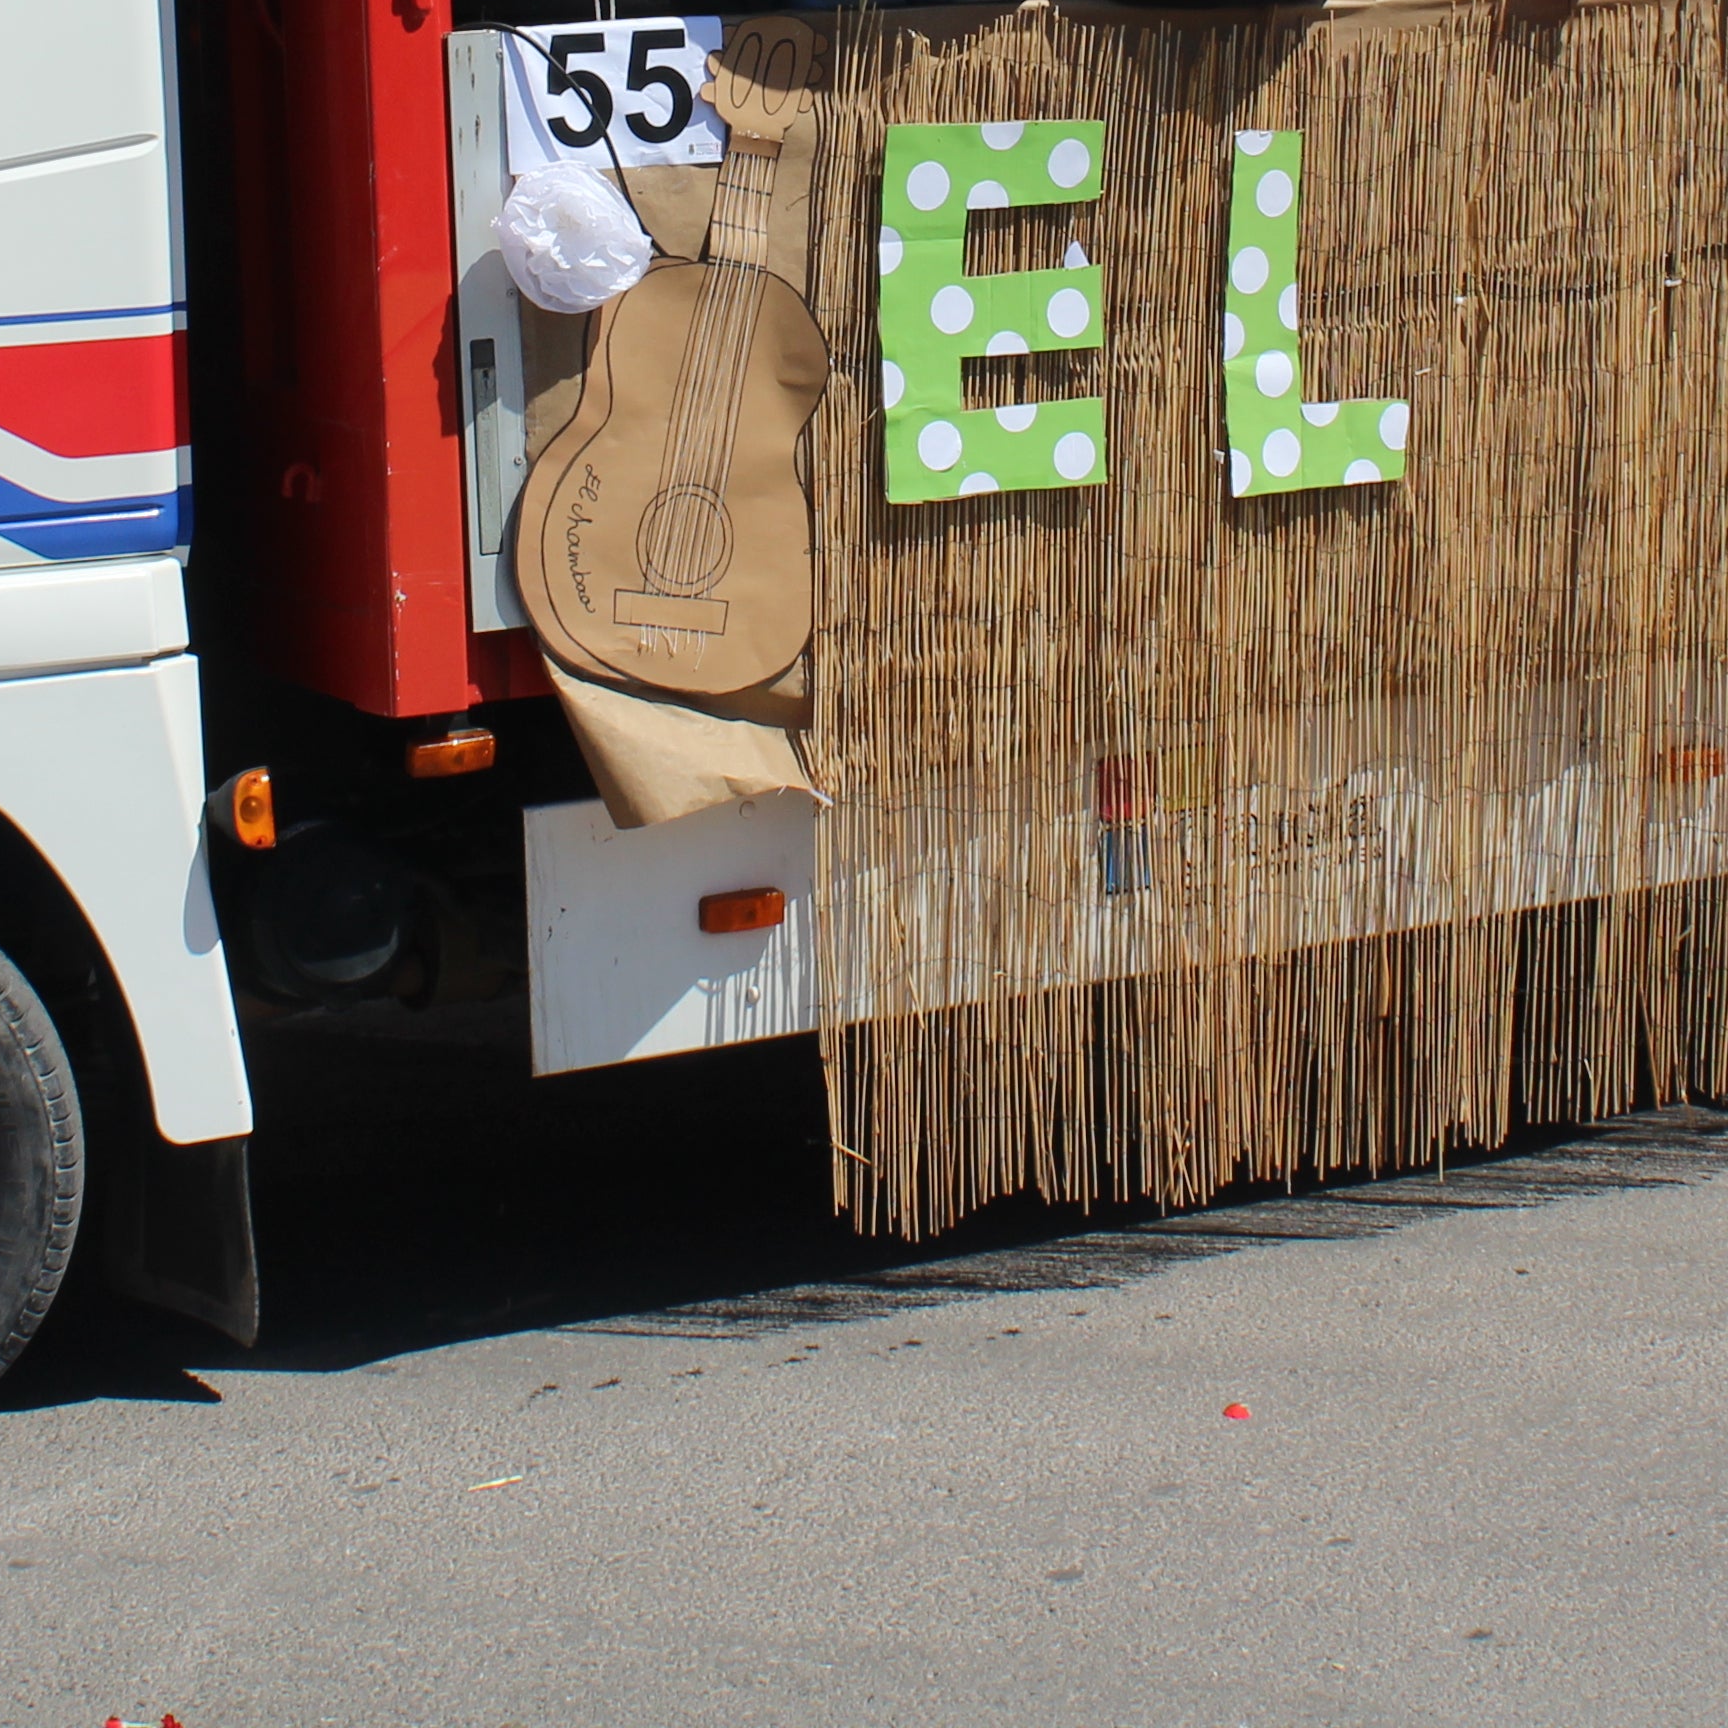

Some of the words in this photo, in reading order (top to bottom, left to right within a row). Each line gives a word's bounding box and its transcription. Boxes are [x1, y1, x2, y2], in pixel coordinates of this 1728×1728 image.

[546, 28, 694, 148] 55
[878, 119, 1411, 505] EL
[578, 463, 602, 503] El
